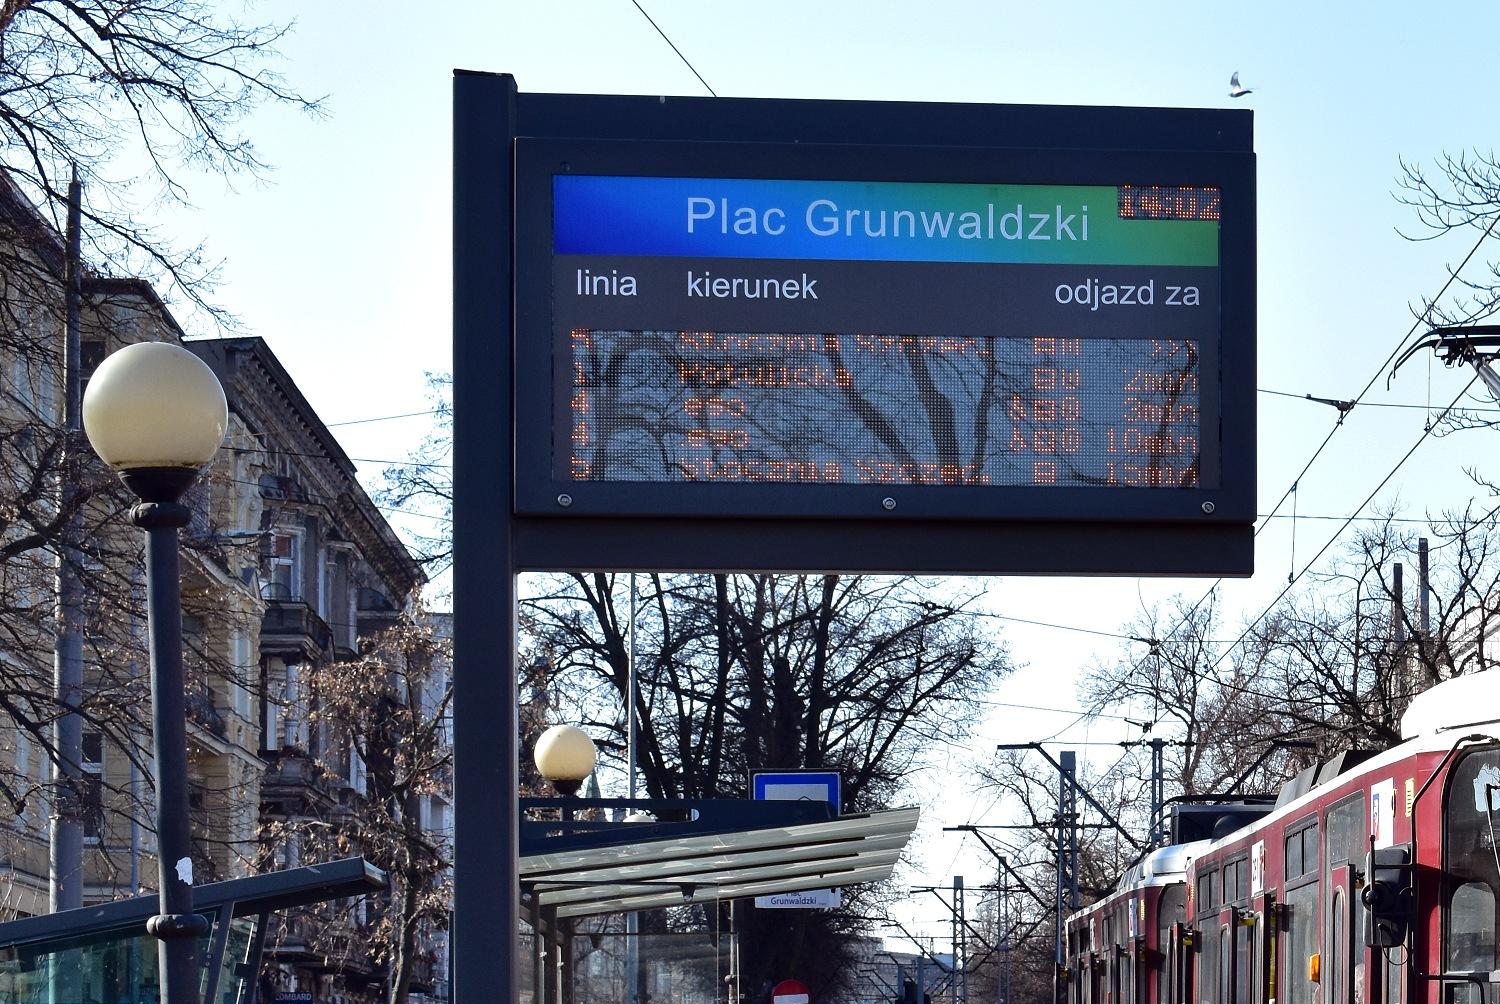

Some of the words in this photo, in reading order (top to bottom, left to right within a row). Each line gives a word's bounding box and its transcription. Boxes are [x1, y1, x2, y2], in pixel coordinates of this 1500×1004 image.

[1119, 184, 1221, 219] 14:02
[687, 197, 786, 236] Plac
[805, 199, 1089, 241] Grunwaldzki
[576, 269, 637, 296] linia
[687, 271, 818, 300] kierunek
[1055, 278, 1154, 311] odjazd
[1165, 285, 1200, 306] za
[571, 389, 589, 415] 4
[571, 421, 589, 447] 4
[770, 896, 817, 905] Grunwaldzki
